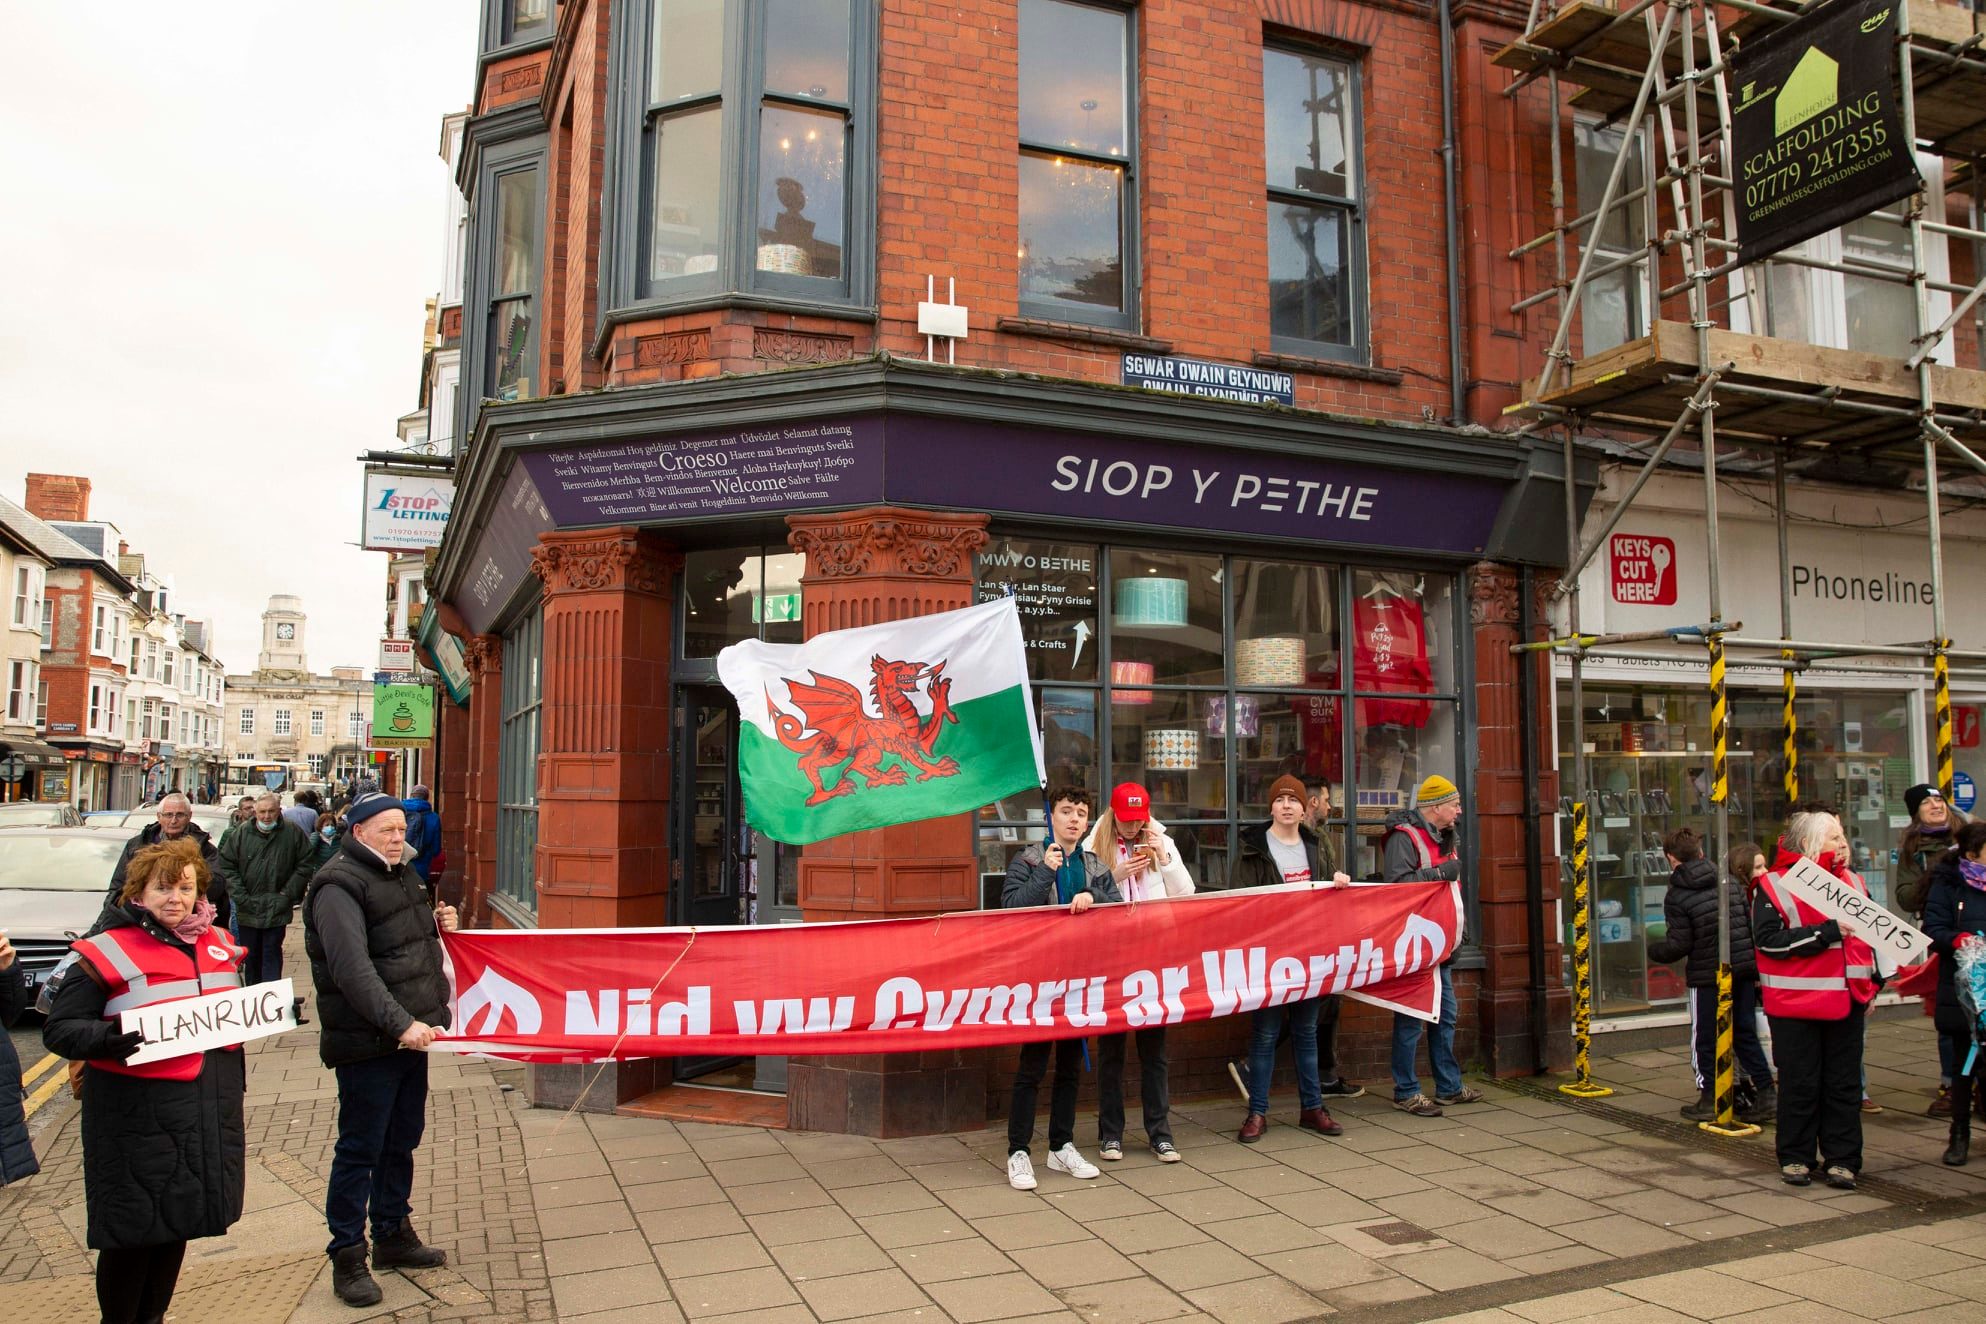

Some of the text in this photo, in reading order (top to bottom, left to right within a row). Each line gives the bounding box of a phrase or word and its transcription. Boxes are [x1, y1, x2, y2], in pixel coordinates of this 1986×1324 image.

[1860, 8, 1890, 32] CHAS
[1777, 93, 1836, 133] GREENHOUSE
[1743, 91, 1880, 181] SCAFFOLDING
[1746, 162, 1801, 208] 07779
[1748, 149, 1892, 222] GREENHOUSESCAFFOLDING.COM
[1179, 362, 1224, 384] OWAIN
[645, 442, 678, 454] geldiniz
[680, 440, 719, 451] Degemer
[720, 436, 737, 446] mat
[740, 432, 780, 444] Üdvözlet
[784, 428, 818, 440] Selamat
[820, 425, 852, 436] datang
[554, 438, 854, 477] Sveiki Witamy Benvinguts Croeso Haere mai Benvinguts Sveiki
[824, 456, 855, 468] Добро
[562, 458, 822, 490] Bienvenidos Merhba Bem-vindos Bienvenue Aloha Haykuykuy!
[657, 484, 712, 496] Willkommen
[710, 476, 788, 495] Welcome
[788, 475, 811, 486] Salve
[1050, 455, 1379, 521] SIOP Y PETHE
[598, 504, 646, 516] Velkommen
[649, 502, 668, 512] Bine
[679, 500, 698, 509] venit
[750, 494, 783, 504] Benvido
[1614, 538, 1651, 558] KEYS
[1024, 556, 1036, 568] O
[1040, 557, 1091, 572] BETHE
[1620, 561, 1648, 580] CUT
[979, 580, 996, 589] Lan
[1022, 583, 1039, 592] Lan
[1041, 584, 1066, 593] Staer
[1616, 582, 1655, 602] HERE
[1792, 565, 1935, 605] Phoneline
[1042, 596, 1064, 606] Fyny
[1065, 596, 1092, 606] Grisie
[1030, 640, 1036, 648] &
[1038, 640, 1066, 649] Crafts
[376, 691, 394, 706] Little
[1796, 866, 1912, 950] LLANBERIS
[1121, 965, 1189, 1026] ar
[1202, 938, 1384, 1018] Werth
[139, 990, 283, 1045] LLANRUG
